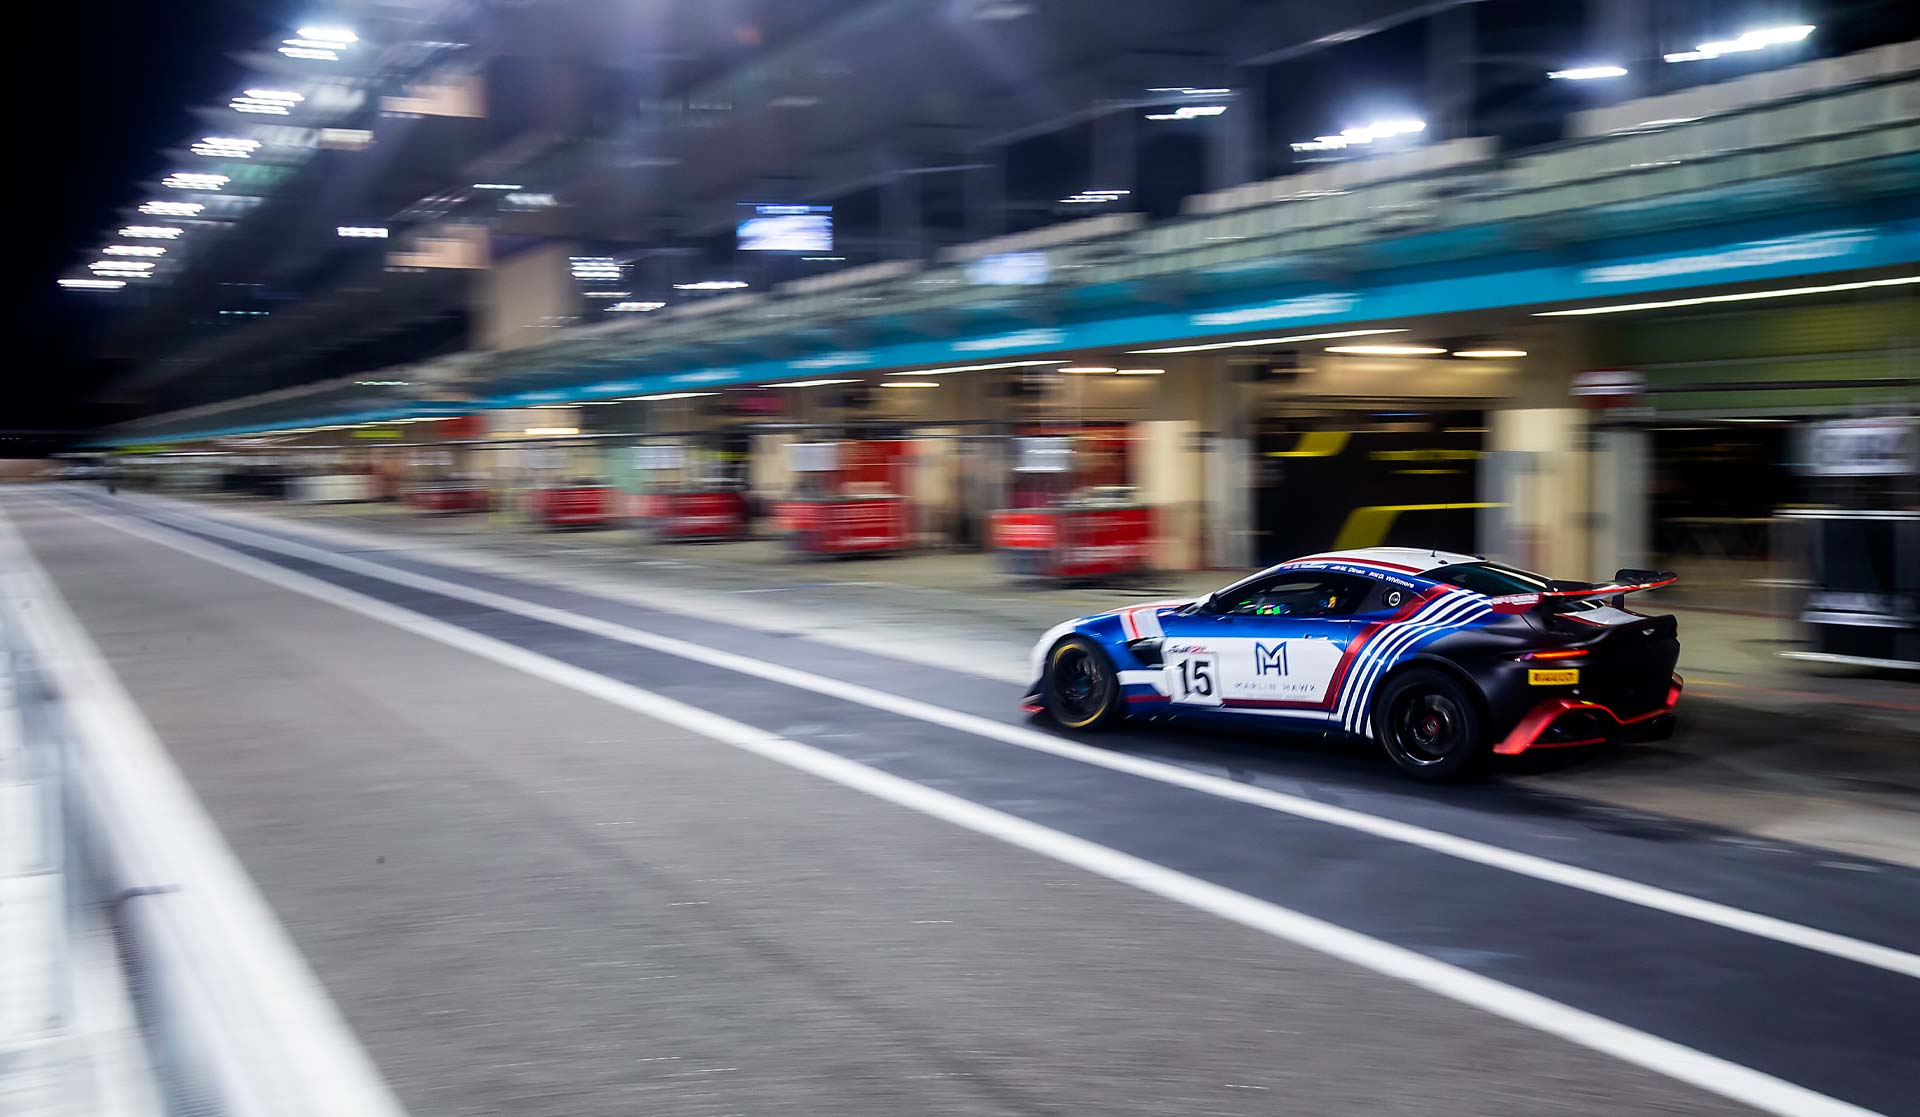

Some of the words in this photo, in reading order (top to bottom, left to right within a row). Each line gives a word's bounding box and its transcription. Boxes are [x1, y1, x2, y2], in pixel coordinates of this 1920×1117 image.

[1348, 567, 1366, 575] Dinan
[1385, 575, 1415, 589] Whitmore
[1178, 659, 1212, 696] 15
